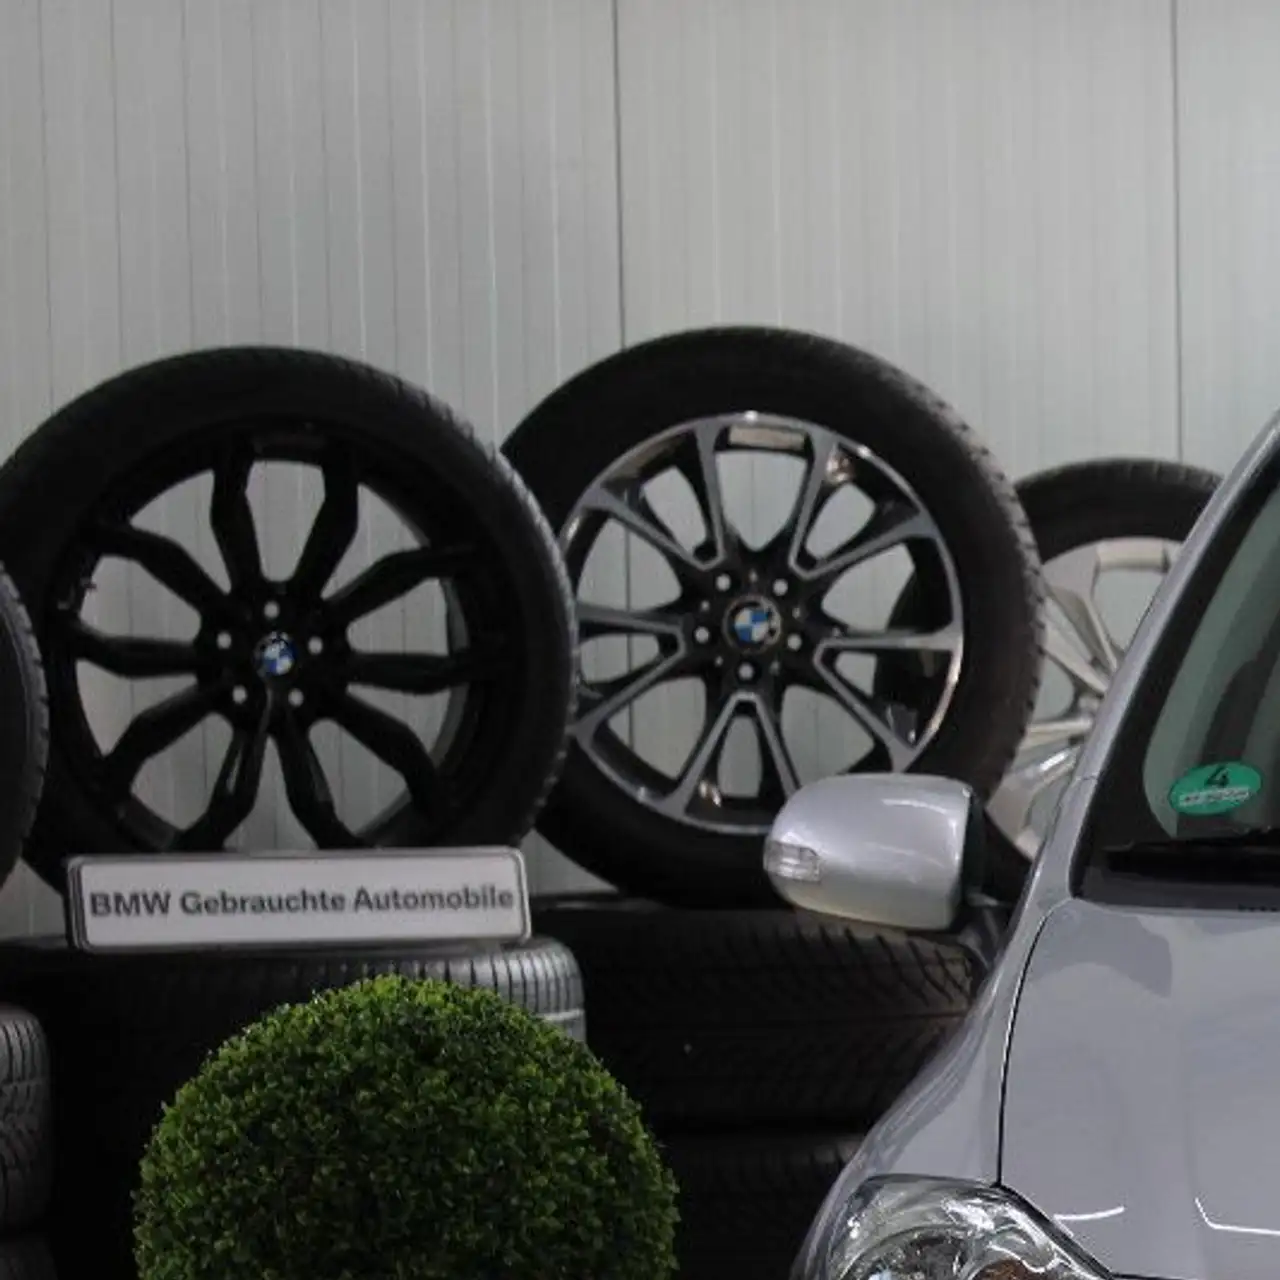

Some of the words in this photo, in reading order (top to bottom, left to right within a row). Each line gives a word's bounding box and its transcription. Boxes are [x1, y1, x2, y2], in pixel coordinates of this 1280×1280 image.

[1204, 766, 1229, 789] 4
[90, 891, 171, 917] BMW
[180, 889, 346, 916] Gebrauchte
[353, 884, 515, 911] Automobile
